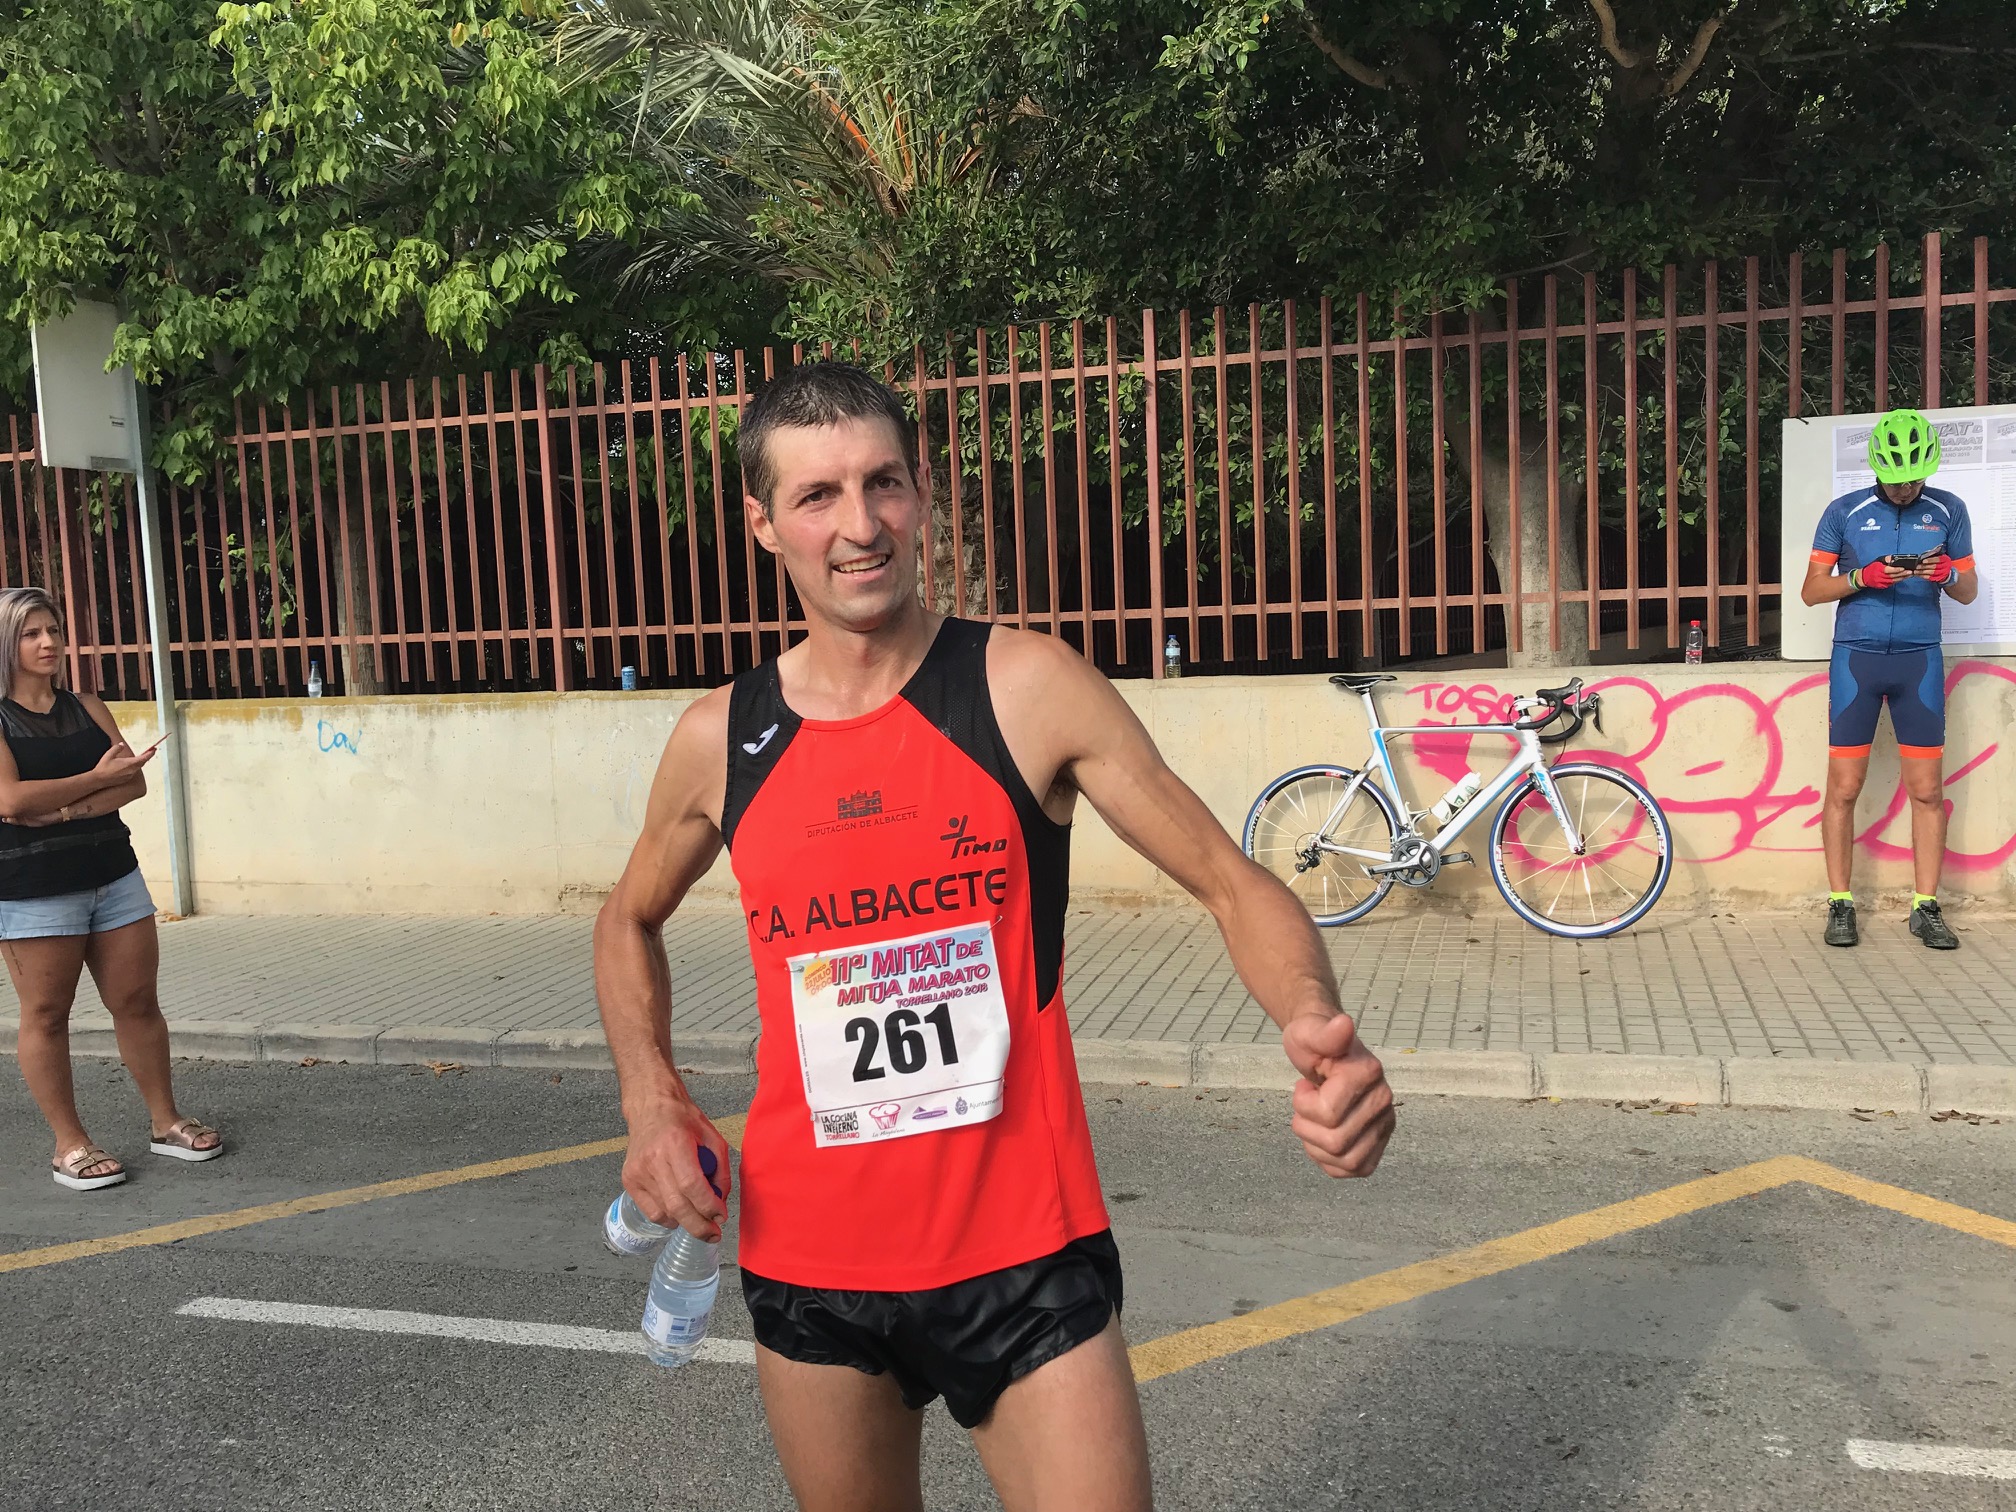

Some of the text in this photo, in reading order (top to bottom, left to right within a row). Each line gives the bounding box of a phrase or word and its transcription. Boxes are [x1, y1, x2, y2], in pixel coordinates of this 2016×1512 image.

[807, 811, 919, 838] DIPUTACIÓN DE ALBACETE
[805, 867, 1007, 934] ALBACETE
[870, 936, 955, 980] MITAT
[955, 939, 983, 960] DE
[837, 963, 991, 1007] MITJA MARATO
[895, 982, 988, 1009] TORRELLANO 2018
[844, 1002, 960, 1083] 261
[830, 1110, 858, 1122] COCINA
